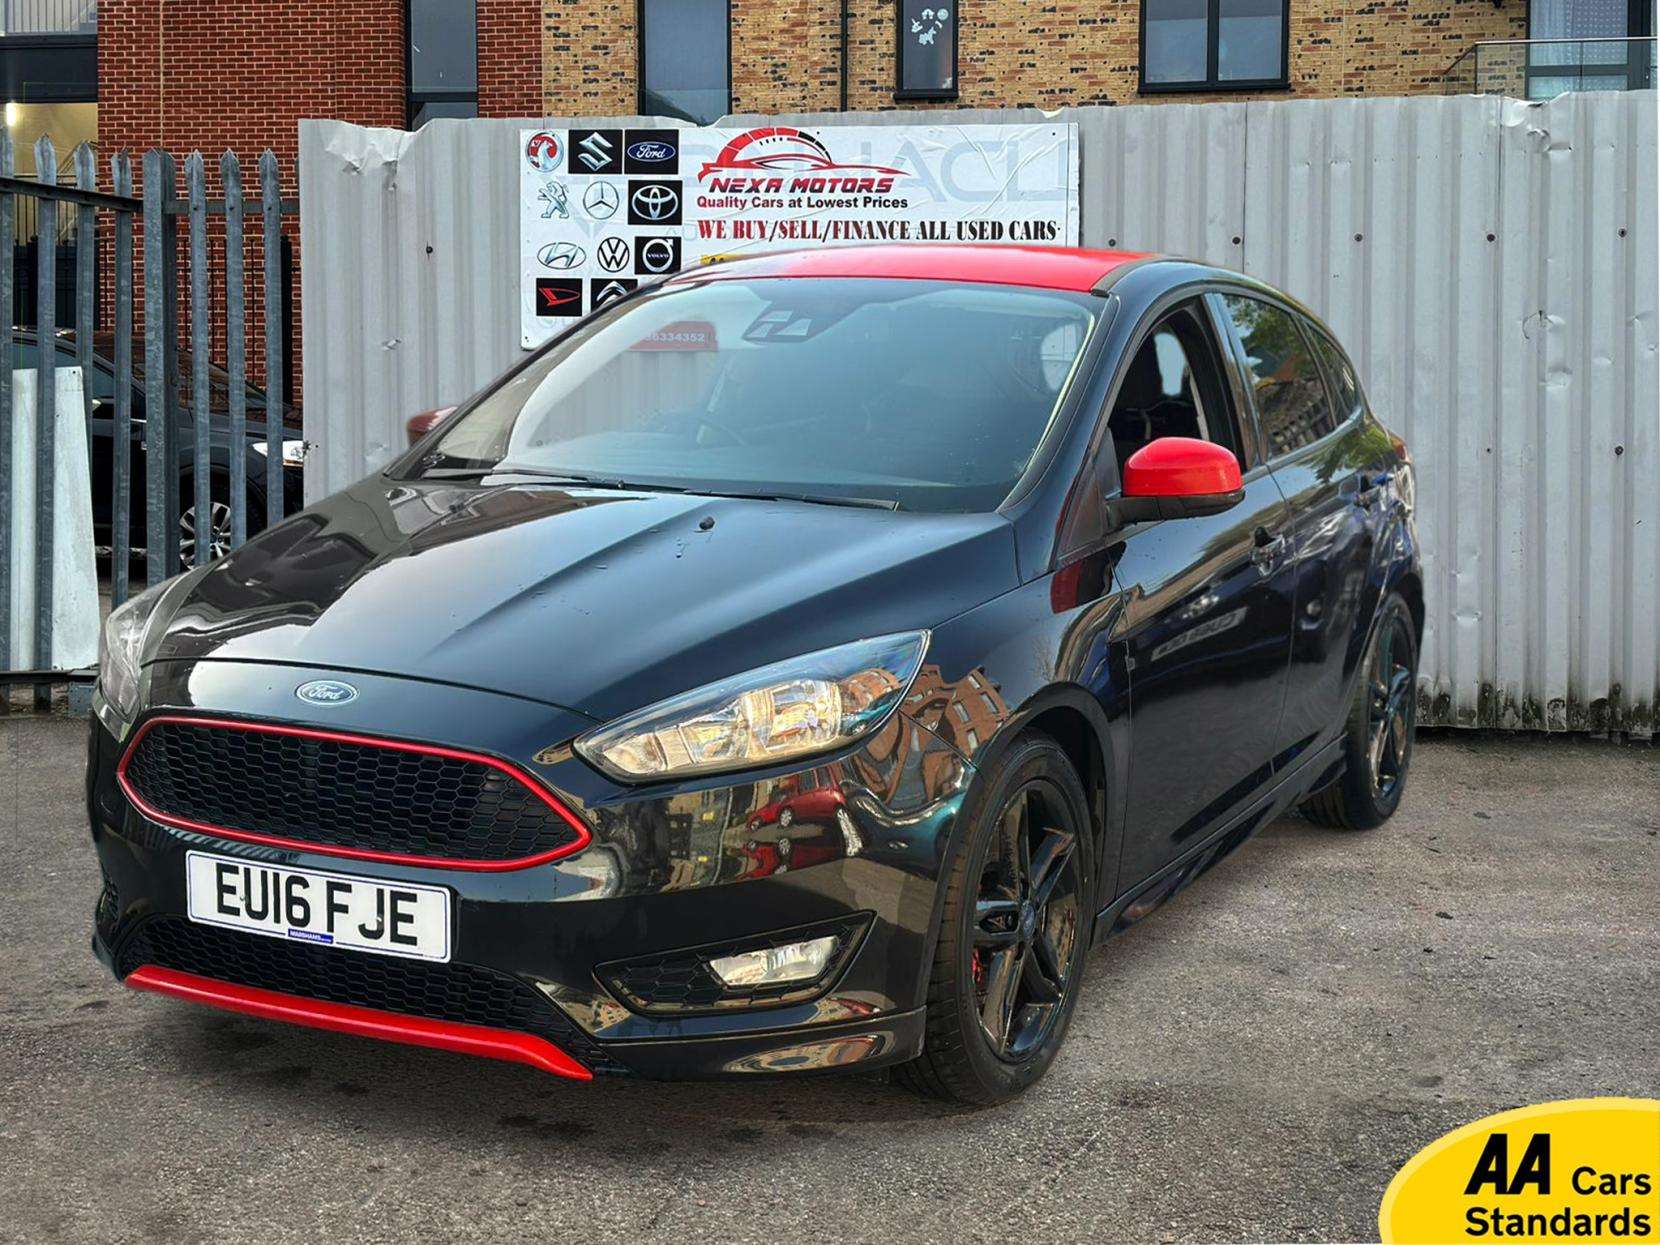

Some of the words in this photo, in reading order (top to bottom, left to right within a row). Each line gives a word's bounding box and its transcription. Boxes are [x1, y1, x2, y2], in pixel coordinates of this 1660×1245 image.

[636, 143, 666, 158] Ford
[709, 178, 783, 193] NEXA
[789, 178, 894, 193] MOTORS
[697, 195, 748, 209] Quality
[752, 196, 784, 208] Cars
[788, 197, 802, 208] at
[807, 196, 859, 208] Lowest
[863, 196, 908, 208] Prices
[698, 220, 727, 240] WE
[916, 220, 951, 240] ALL
[956, 220, 1004, 240] USED
[1009, 220, 1057, 240] CARS
[215, 862, 312, 929] EU16
